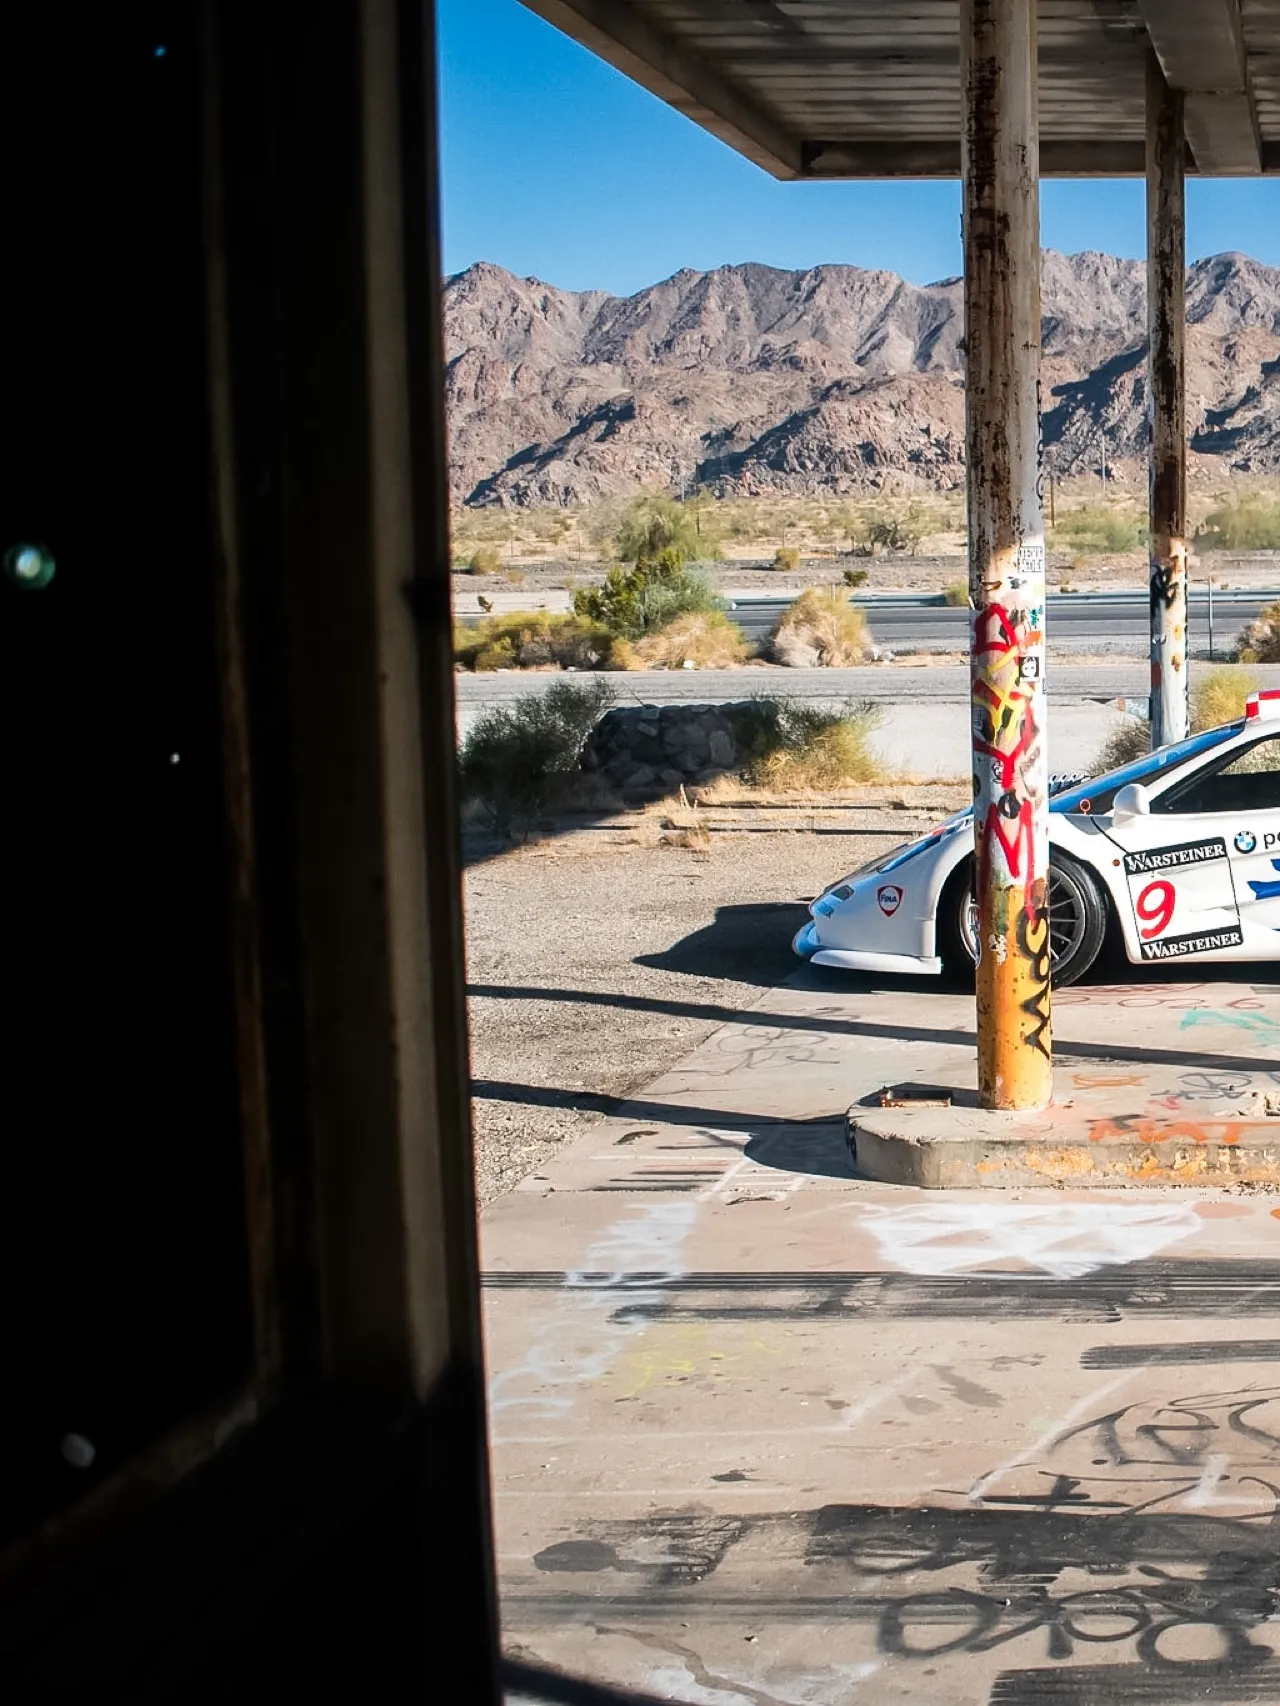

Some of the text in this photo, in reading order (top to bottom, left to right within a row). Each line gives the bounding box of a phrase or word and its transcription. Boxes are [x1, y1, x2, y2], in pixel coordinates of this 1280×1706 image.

[1126, 843, 1226, 872] WARSTEINER
[880, 894, 898, 902] FINA
[1136, 880, 1177, 939] 9
[1143, 932, 1242, 959] WARSTEINER
